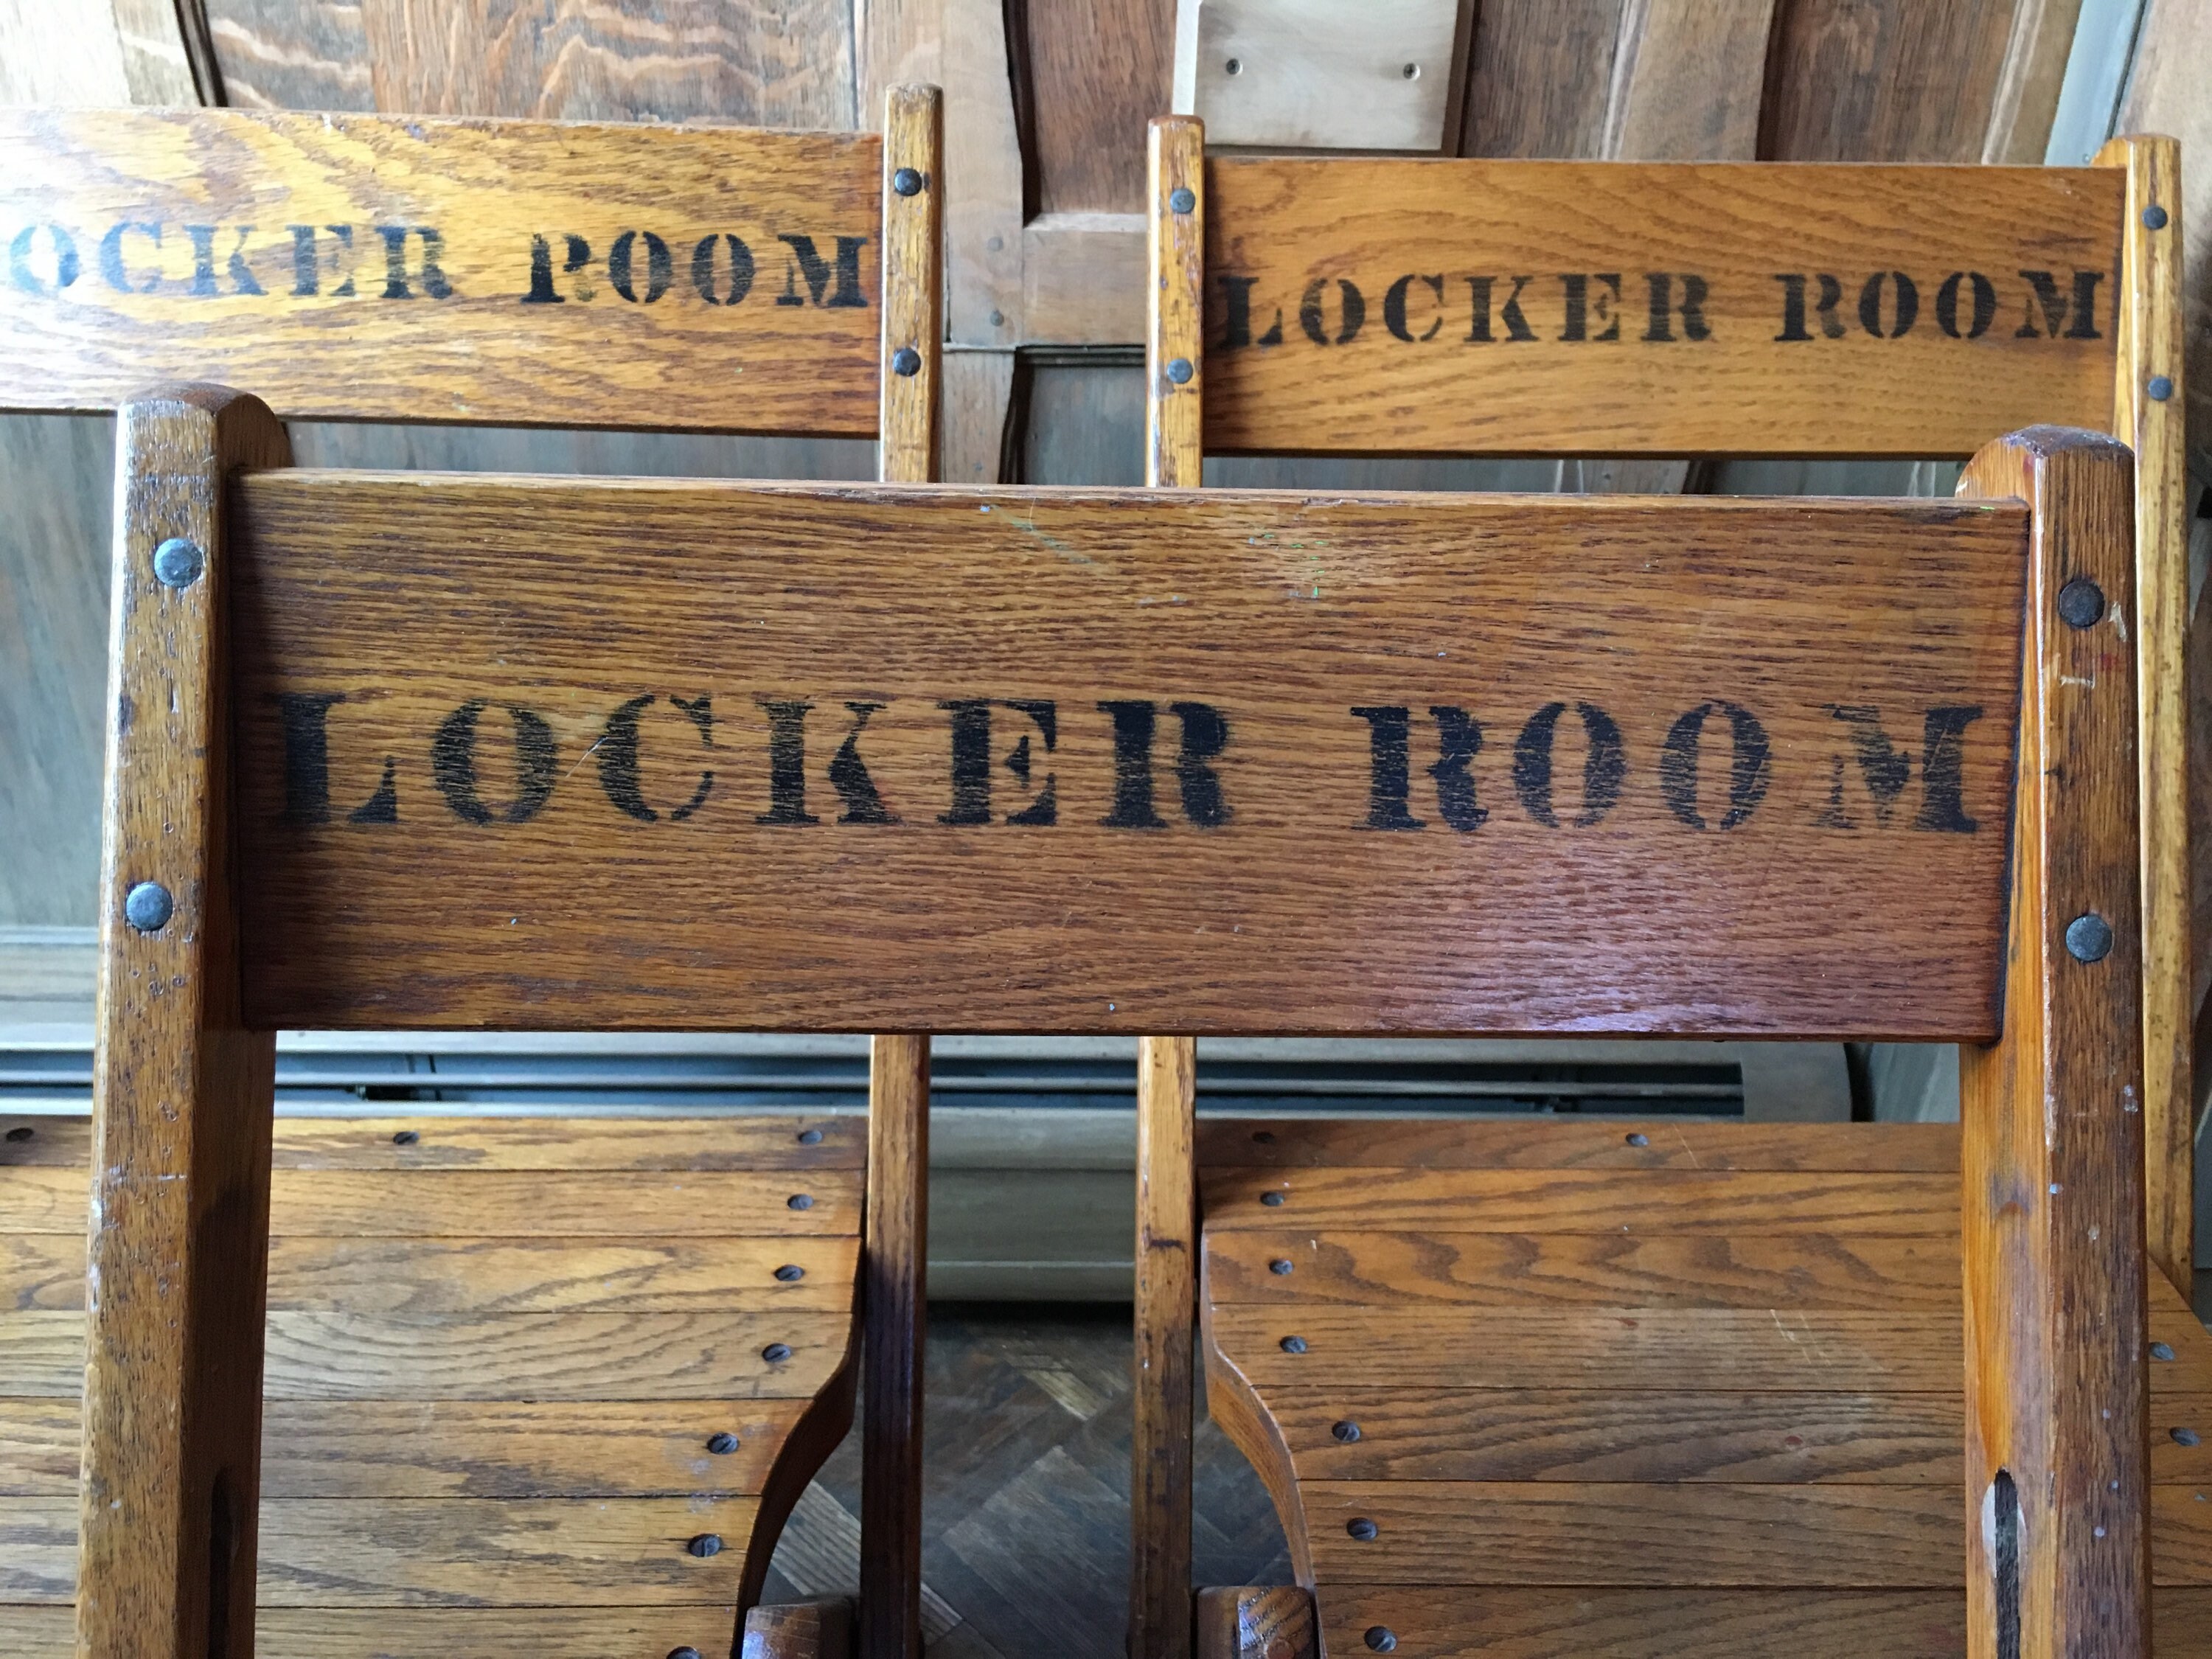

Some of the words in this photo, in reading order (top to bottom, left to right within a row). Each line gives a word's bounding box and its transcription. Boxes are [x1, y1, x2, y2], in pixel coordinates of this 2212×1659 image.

[519, 229, 869, 307] ROOM
[1217, 273, 1713, 347] LOCKER
[1773, 270, 2106, 341] ROOM
[274, 690, 1236, 829] LOCKER
[1351, 699, 1985, 833] ROOM
